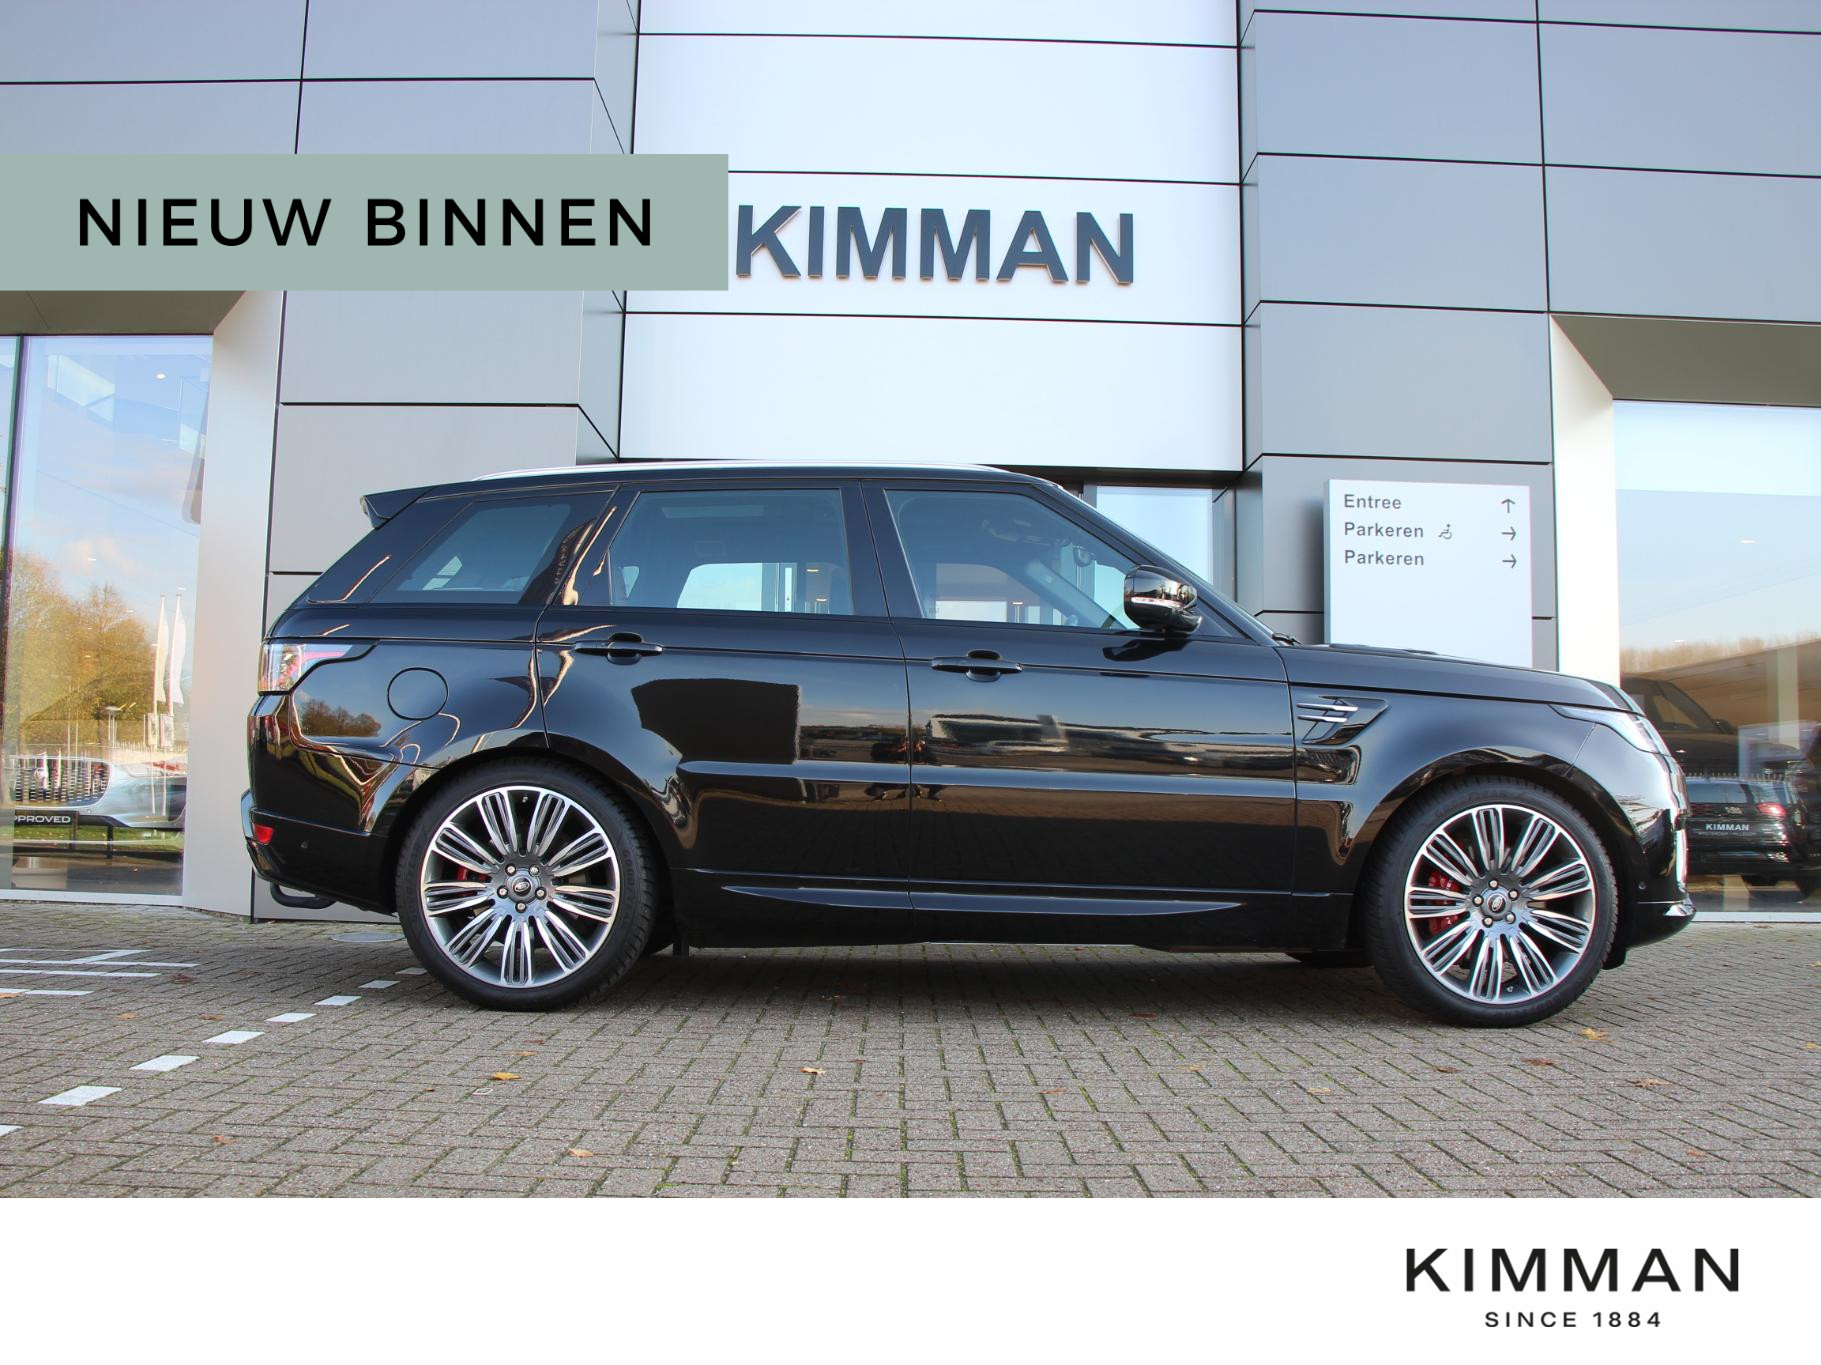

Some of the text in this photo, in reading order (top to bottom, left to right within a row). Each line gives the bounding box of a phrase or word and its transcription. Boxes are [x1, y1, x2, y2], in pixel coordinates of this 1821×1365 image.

[735, 204, 1134, 287] KIMMAN
[1344, 493, 1402, 510] Entree
[1344, 521, 1424, 538] Parkeren
[1344, 549, 1424, 566] Parkeren
[15, 815, 71, 823] PROVED
[1705, 823, 1750, 831] KIMMAN
